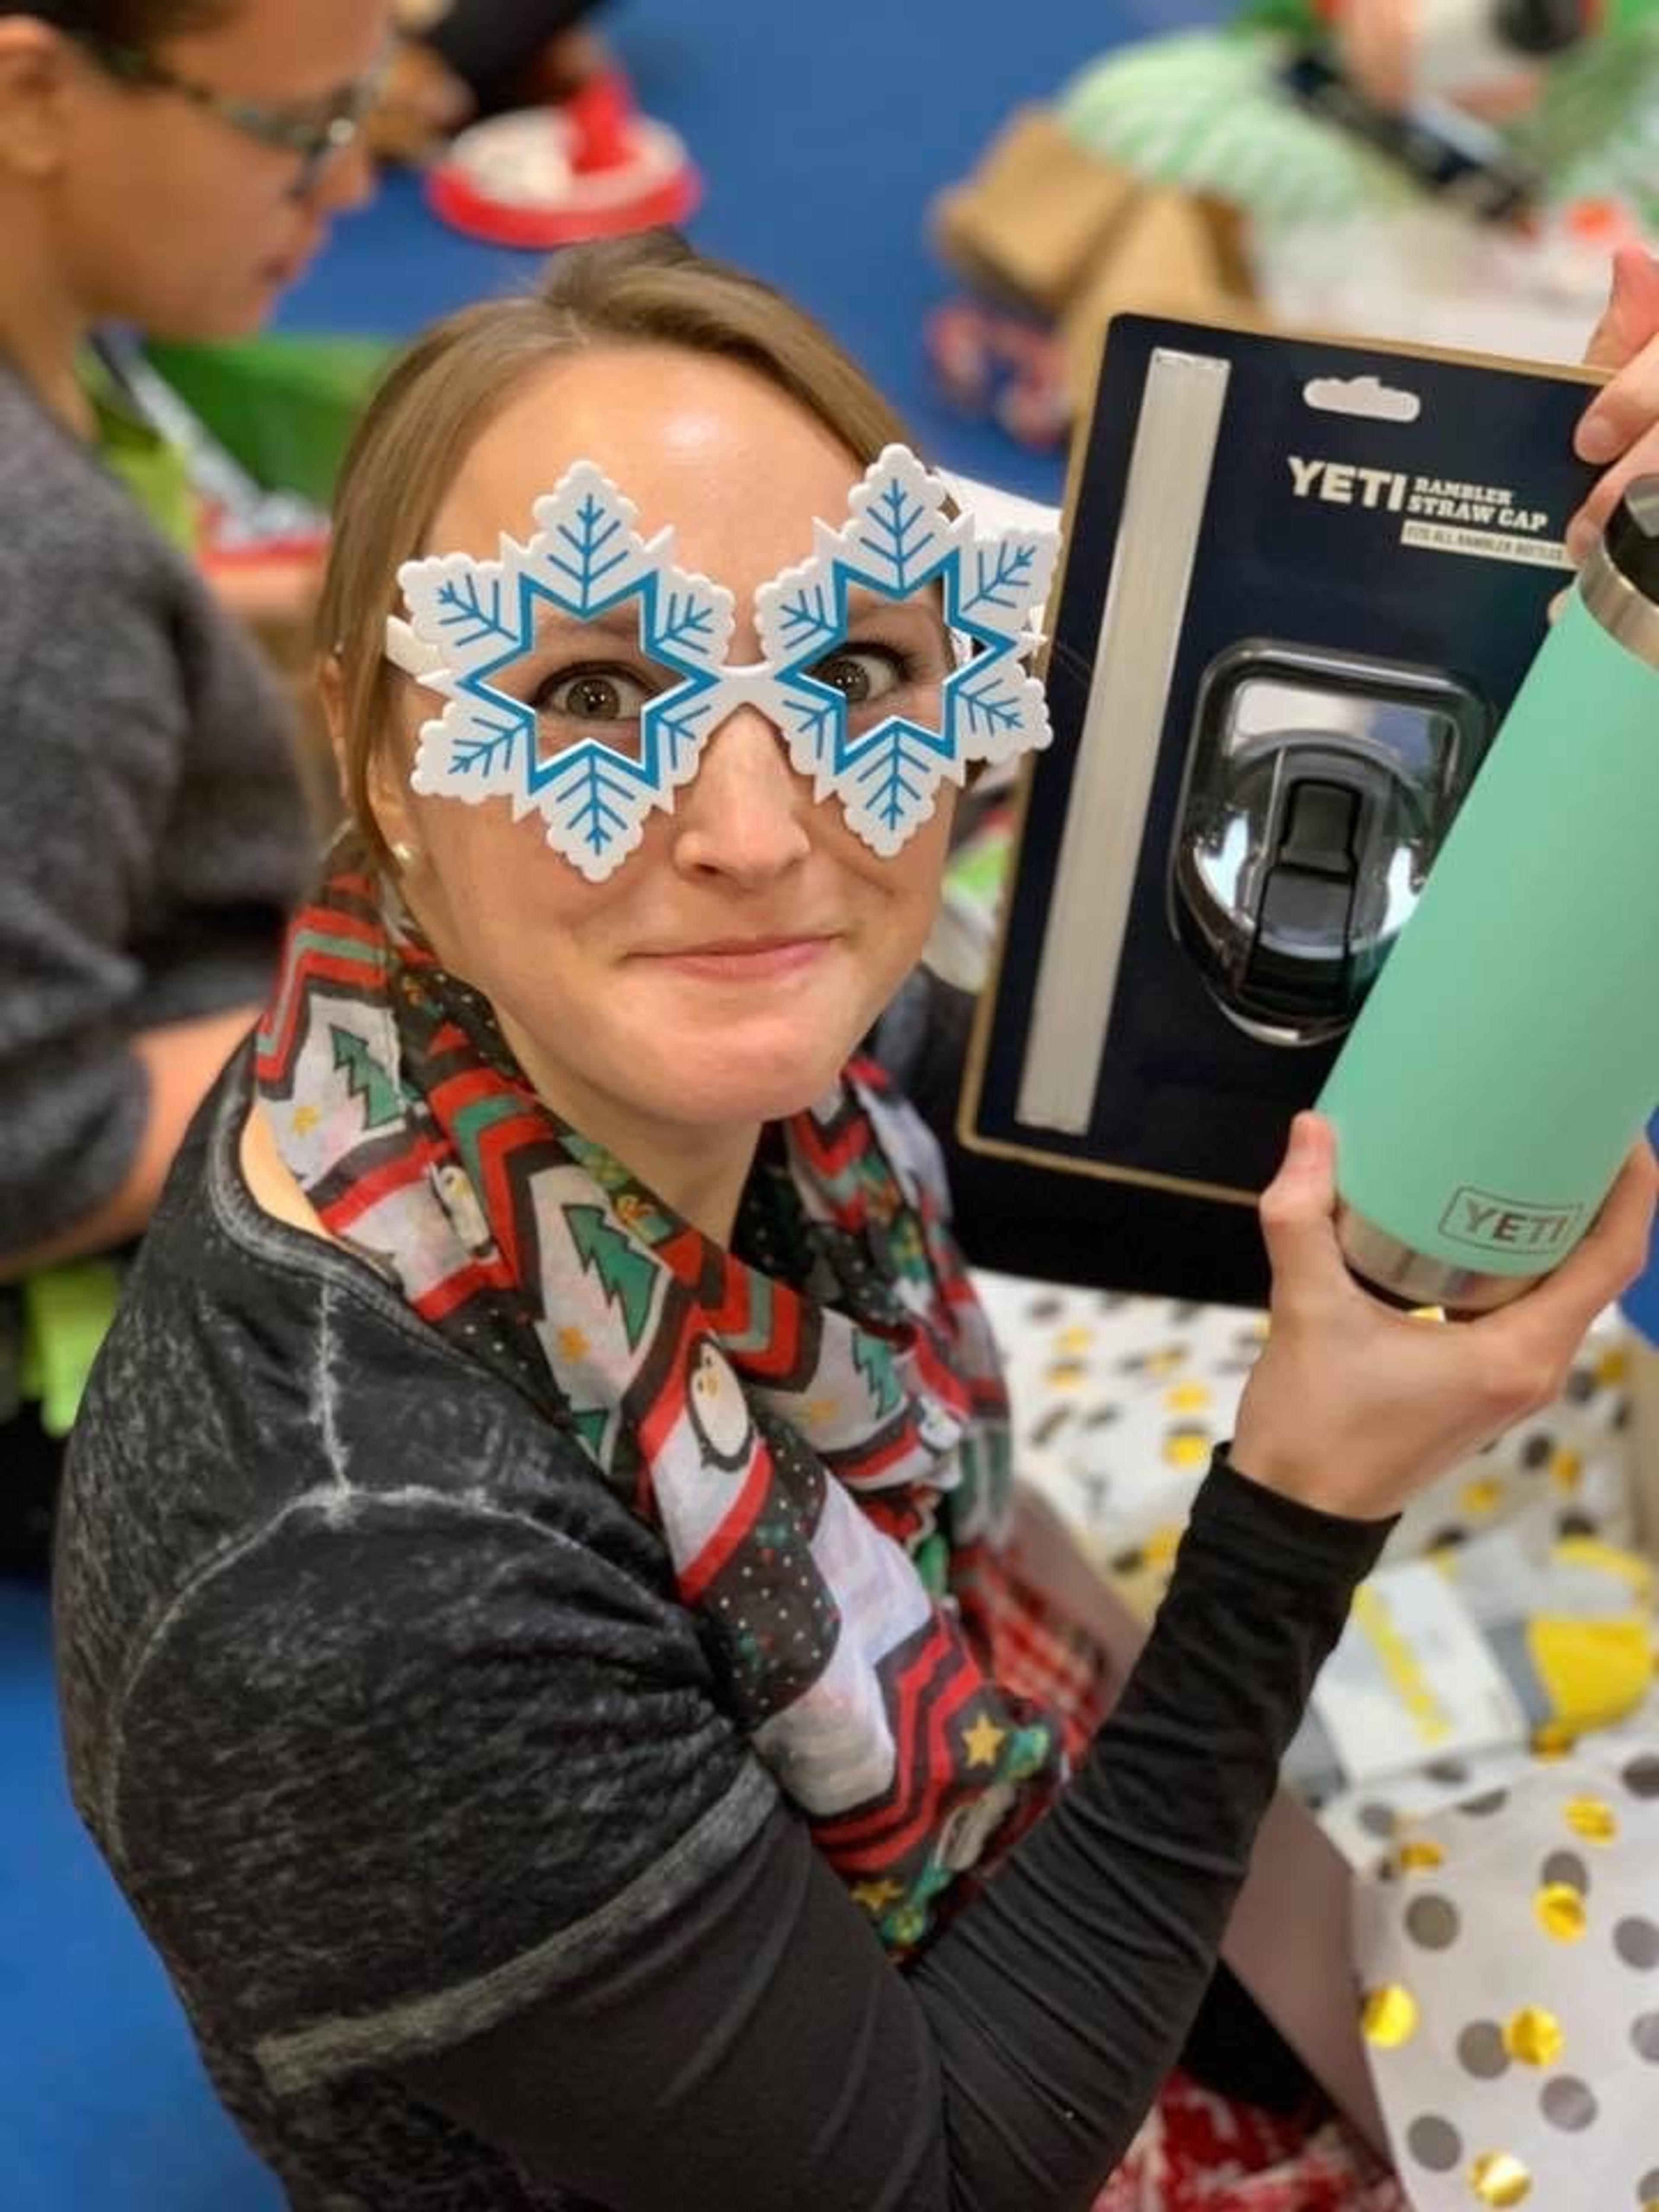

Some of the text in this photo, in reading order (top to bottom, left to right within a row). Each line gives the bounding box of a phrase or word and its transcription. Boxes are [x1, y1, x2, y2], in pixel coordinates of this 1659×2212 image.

[1287, 456, 1407, 512] YETI
[1414, 477, 1513, 505] RAMBLER
[1407, 495, 1548, 531] STRAW CAP
[1465, 1197, 1569, 1243] YETI
